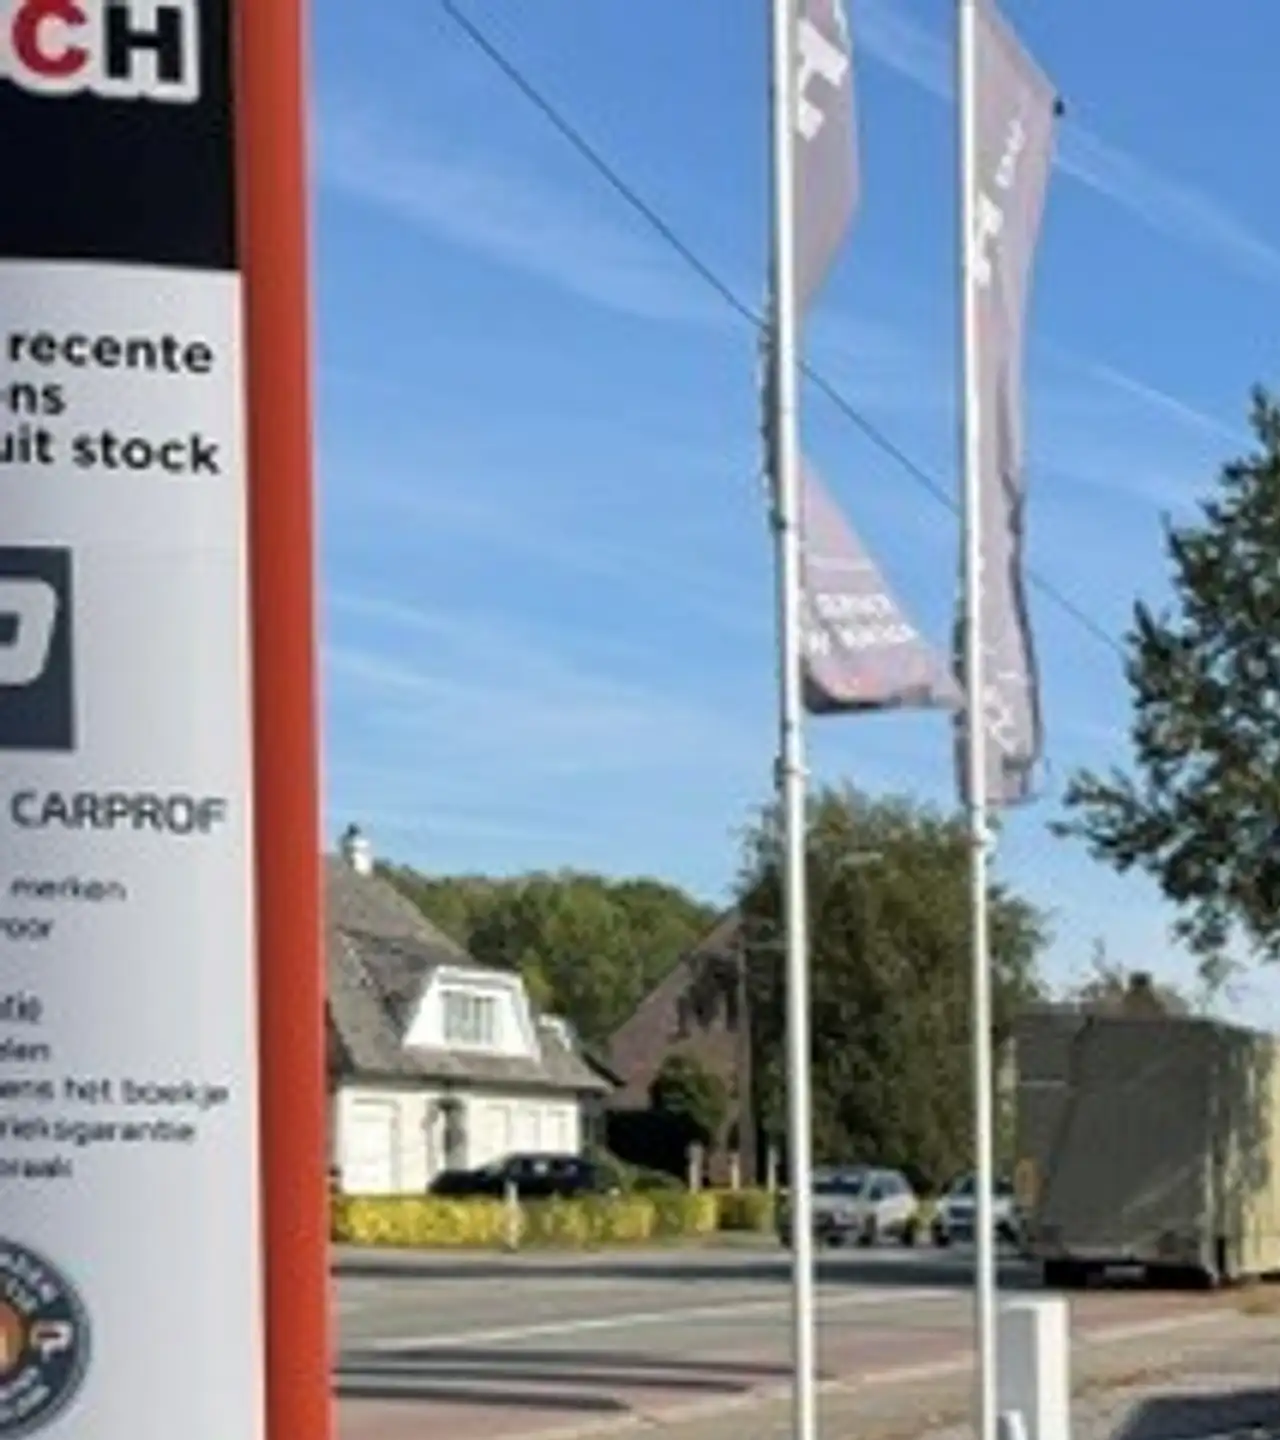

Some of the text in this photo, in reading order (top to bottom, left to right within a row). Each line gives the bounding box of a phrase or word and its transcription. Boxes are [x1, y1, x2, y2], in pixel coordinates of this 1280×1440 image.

[8, 332, 214, 375] recente
[0, 380, 67, 416] ns
[71, 427, 221, 475] stock
[10, 790, 228, 835] CARPROF
